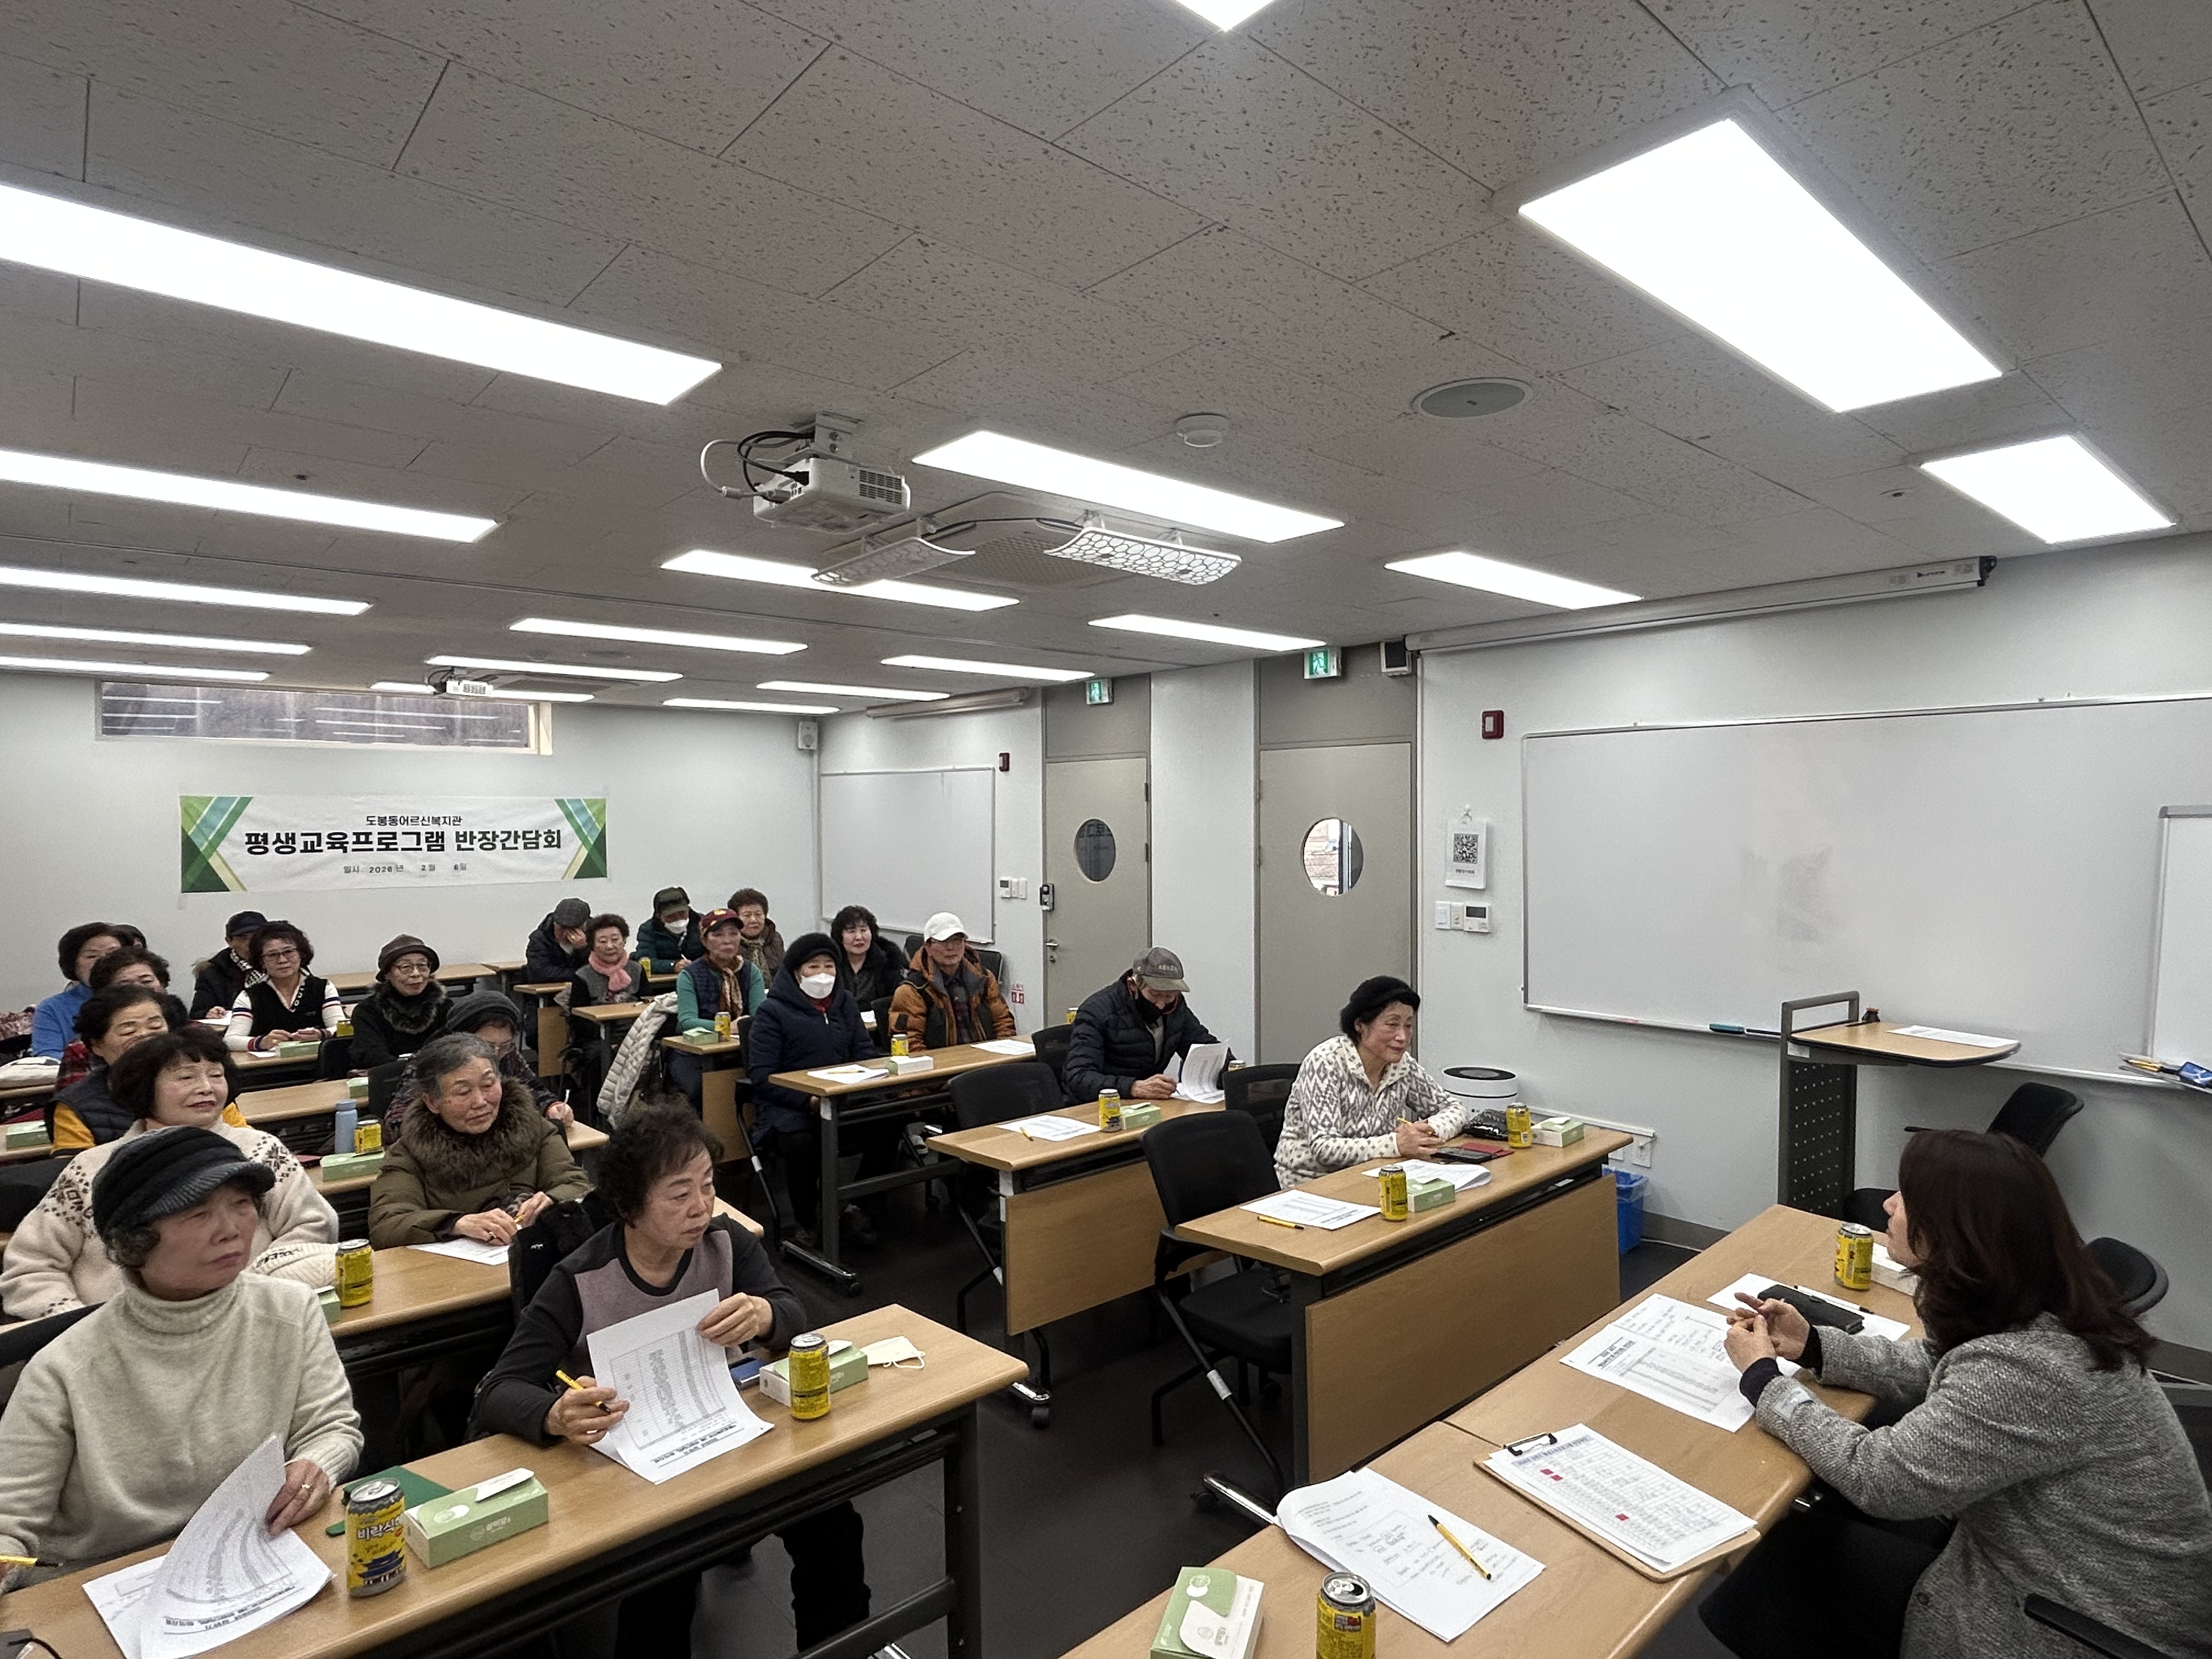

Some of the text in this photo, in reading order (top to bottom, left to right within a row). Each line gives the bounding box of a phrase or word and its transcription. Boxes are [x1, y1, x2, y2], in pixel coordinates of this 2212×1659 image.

[366, 815, 462, 826] 도봉동어르신복지관
[245, 829, 561, 855] 평생교육프로그램 반장간담회
